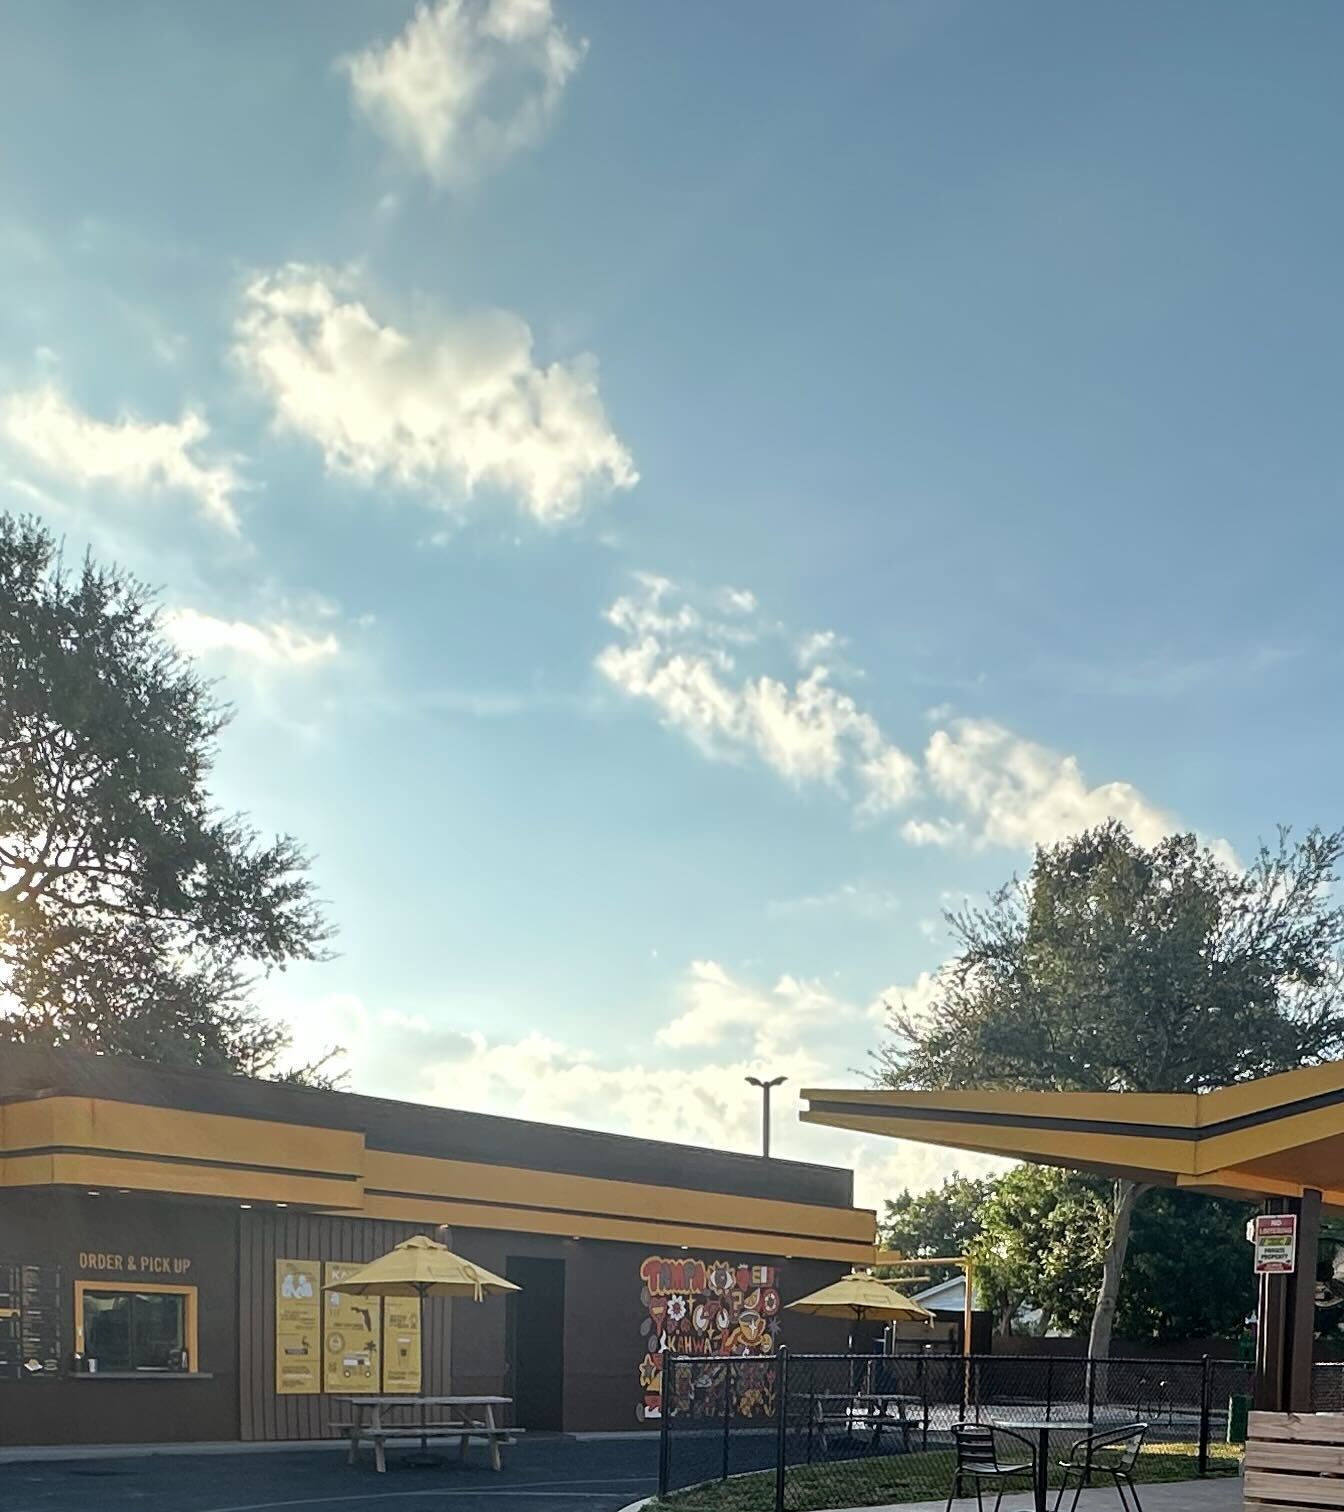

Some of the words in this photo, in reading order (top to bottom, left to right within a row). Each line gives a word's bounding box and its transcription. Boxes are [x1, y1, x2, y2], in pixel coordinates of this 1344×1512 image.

[79, 1252, 123, 1270] ORDER
[127, 1255, 137, 1271] &
[140, 1256, 171, 1273] PICK
[174, 1258, 191, 1274] UP
[642, 1257, 706, 1294] TAMPA
[668, 1335, 712, 1354] KAHWA
